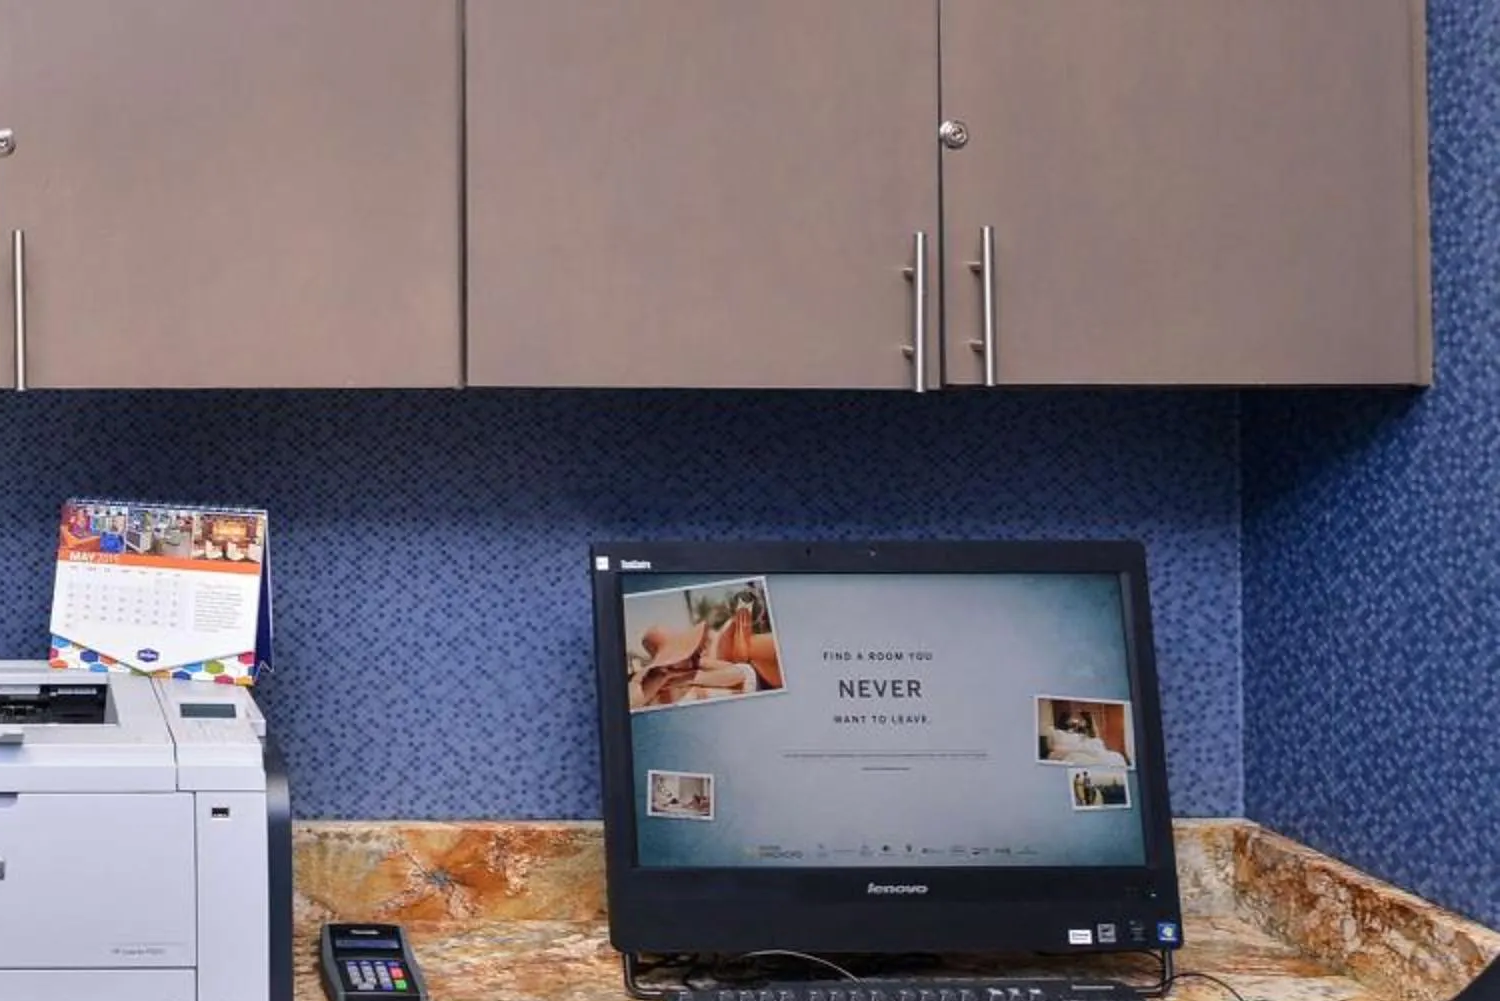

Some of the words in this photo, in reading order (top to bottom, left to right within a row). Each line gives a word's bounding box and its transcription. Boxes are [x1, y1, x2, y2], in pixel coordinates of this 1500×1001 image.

[822, 651, 851, 661] FIND
[856, 651, 864, 661] A
[867, 651, 903, 661] ROOM
[908, 651, 933, 661] YOU
[838, 679, 922, 699] NEVER
[833, 715, 867, 724] WANT
[871, 715, 887, 724] TO
[867, 882, 929, 895] lenovo
